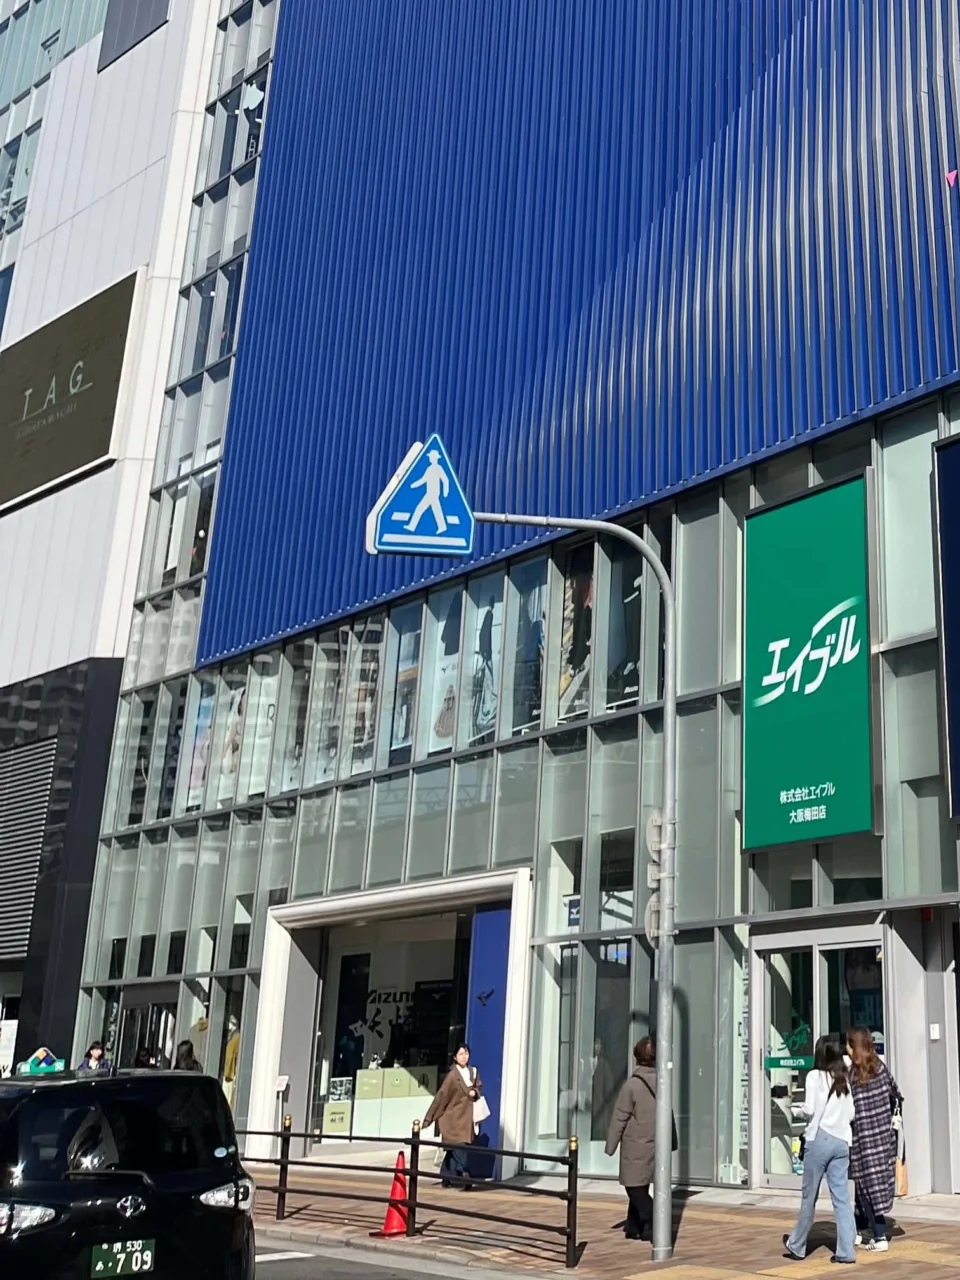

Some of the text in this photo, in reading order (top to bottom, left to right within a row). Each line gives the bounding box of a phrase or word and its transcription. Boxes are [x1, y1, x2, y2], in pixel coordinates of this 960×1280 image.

[760, 611, 861, 696] エイブル
[780, 781, 836, 805] 株式会社エイブル
[789, 804, 827, 824] 大阪梅田店
[126, 1239, 143, 1252] 530
